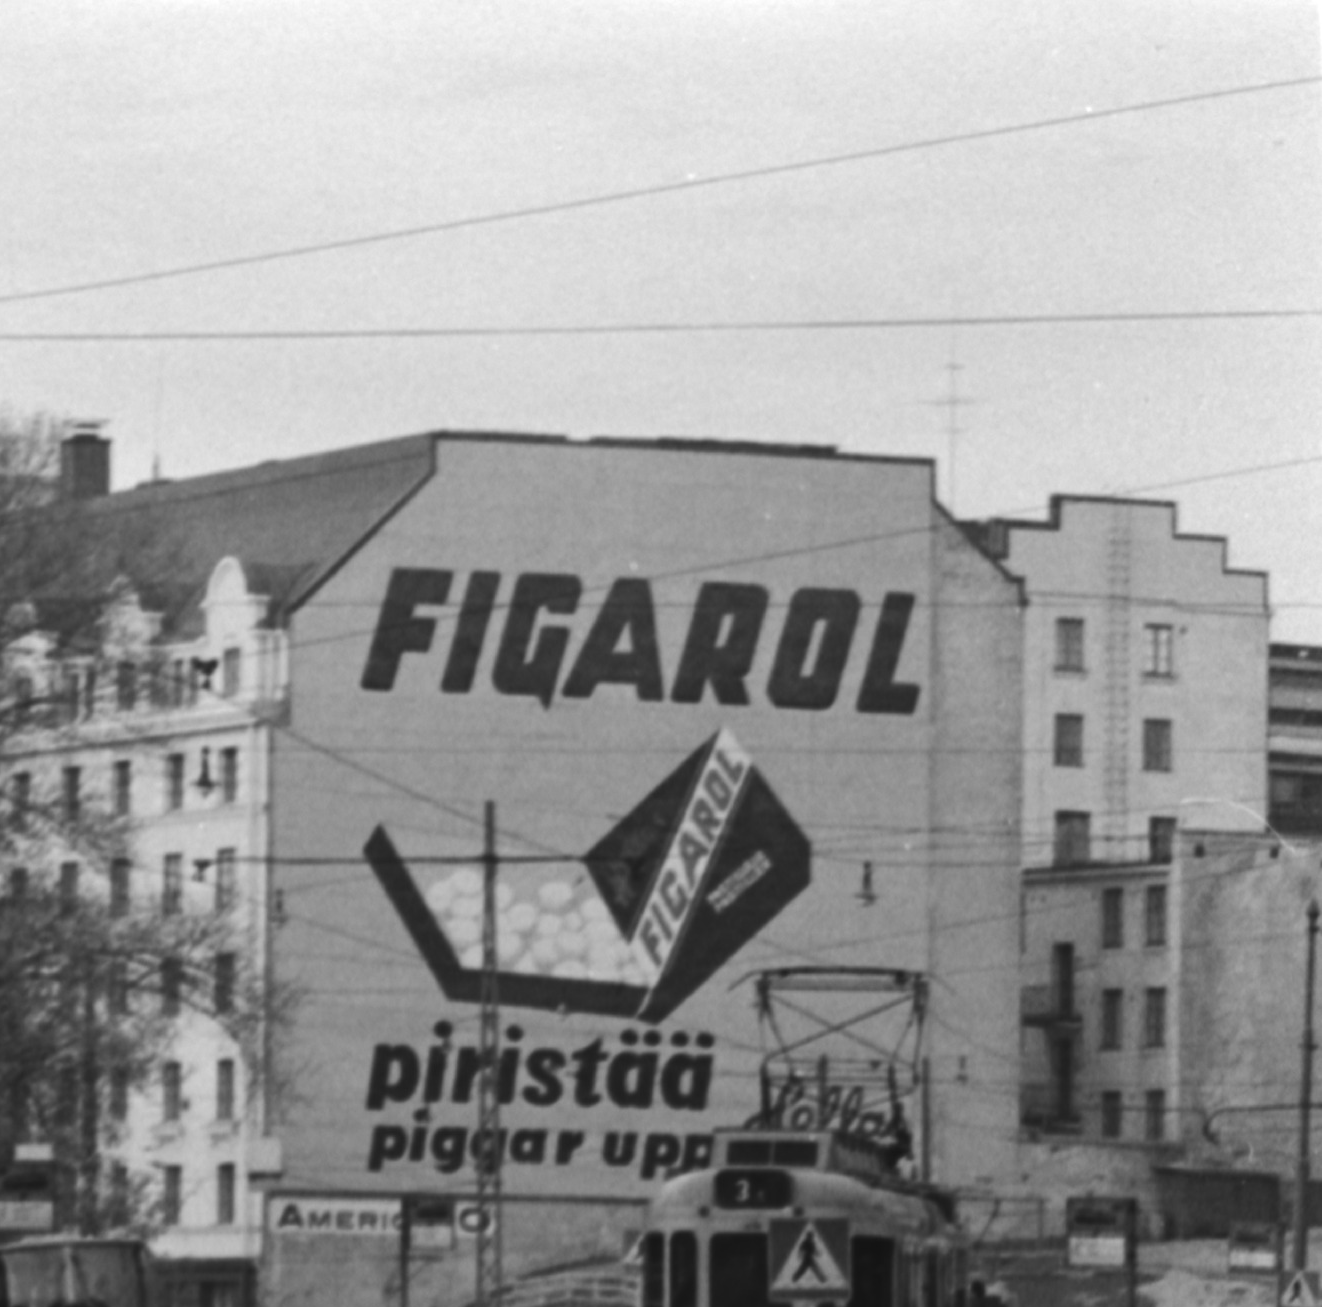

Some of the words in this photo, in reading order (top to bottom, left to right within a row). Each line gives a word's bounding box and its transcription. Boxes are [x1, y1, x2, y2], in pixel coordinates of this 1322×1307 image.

[360, 567, 920, 715] FIGAROL
[638, 748, 746, 967] FIGAROL
[365, 1020, 715, 1111] piristää
[366, 1107, 585, 1174] piggar
[602, 1130, 714, 1181] upp
